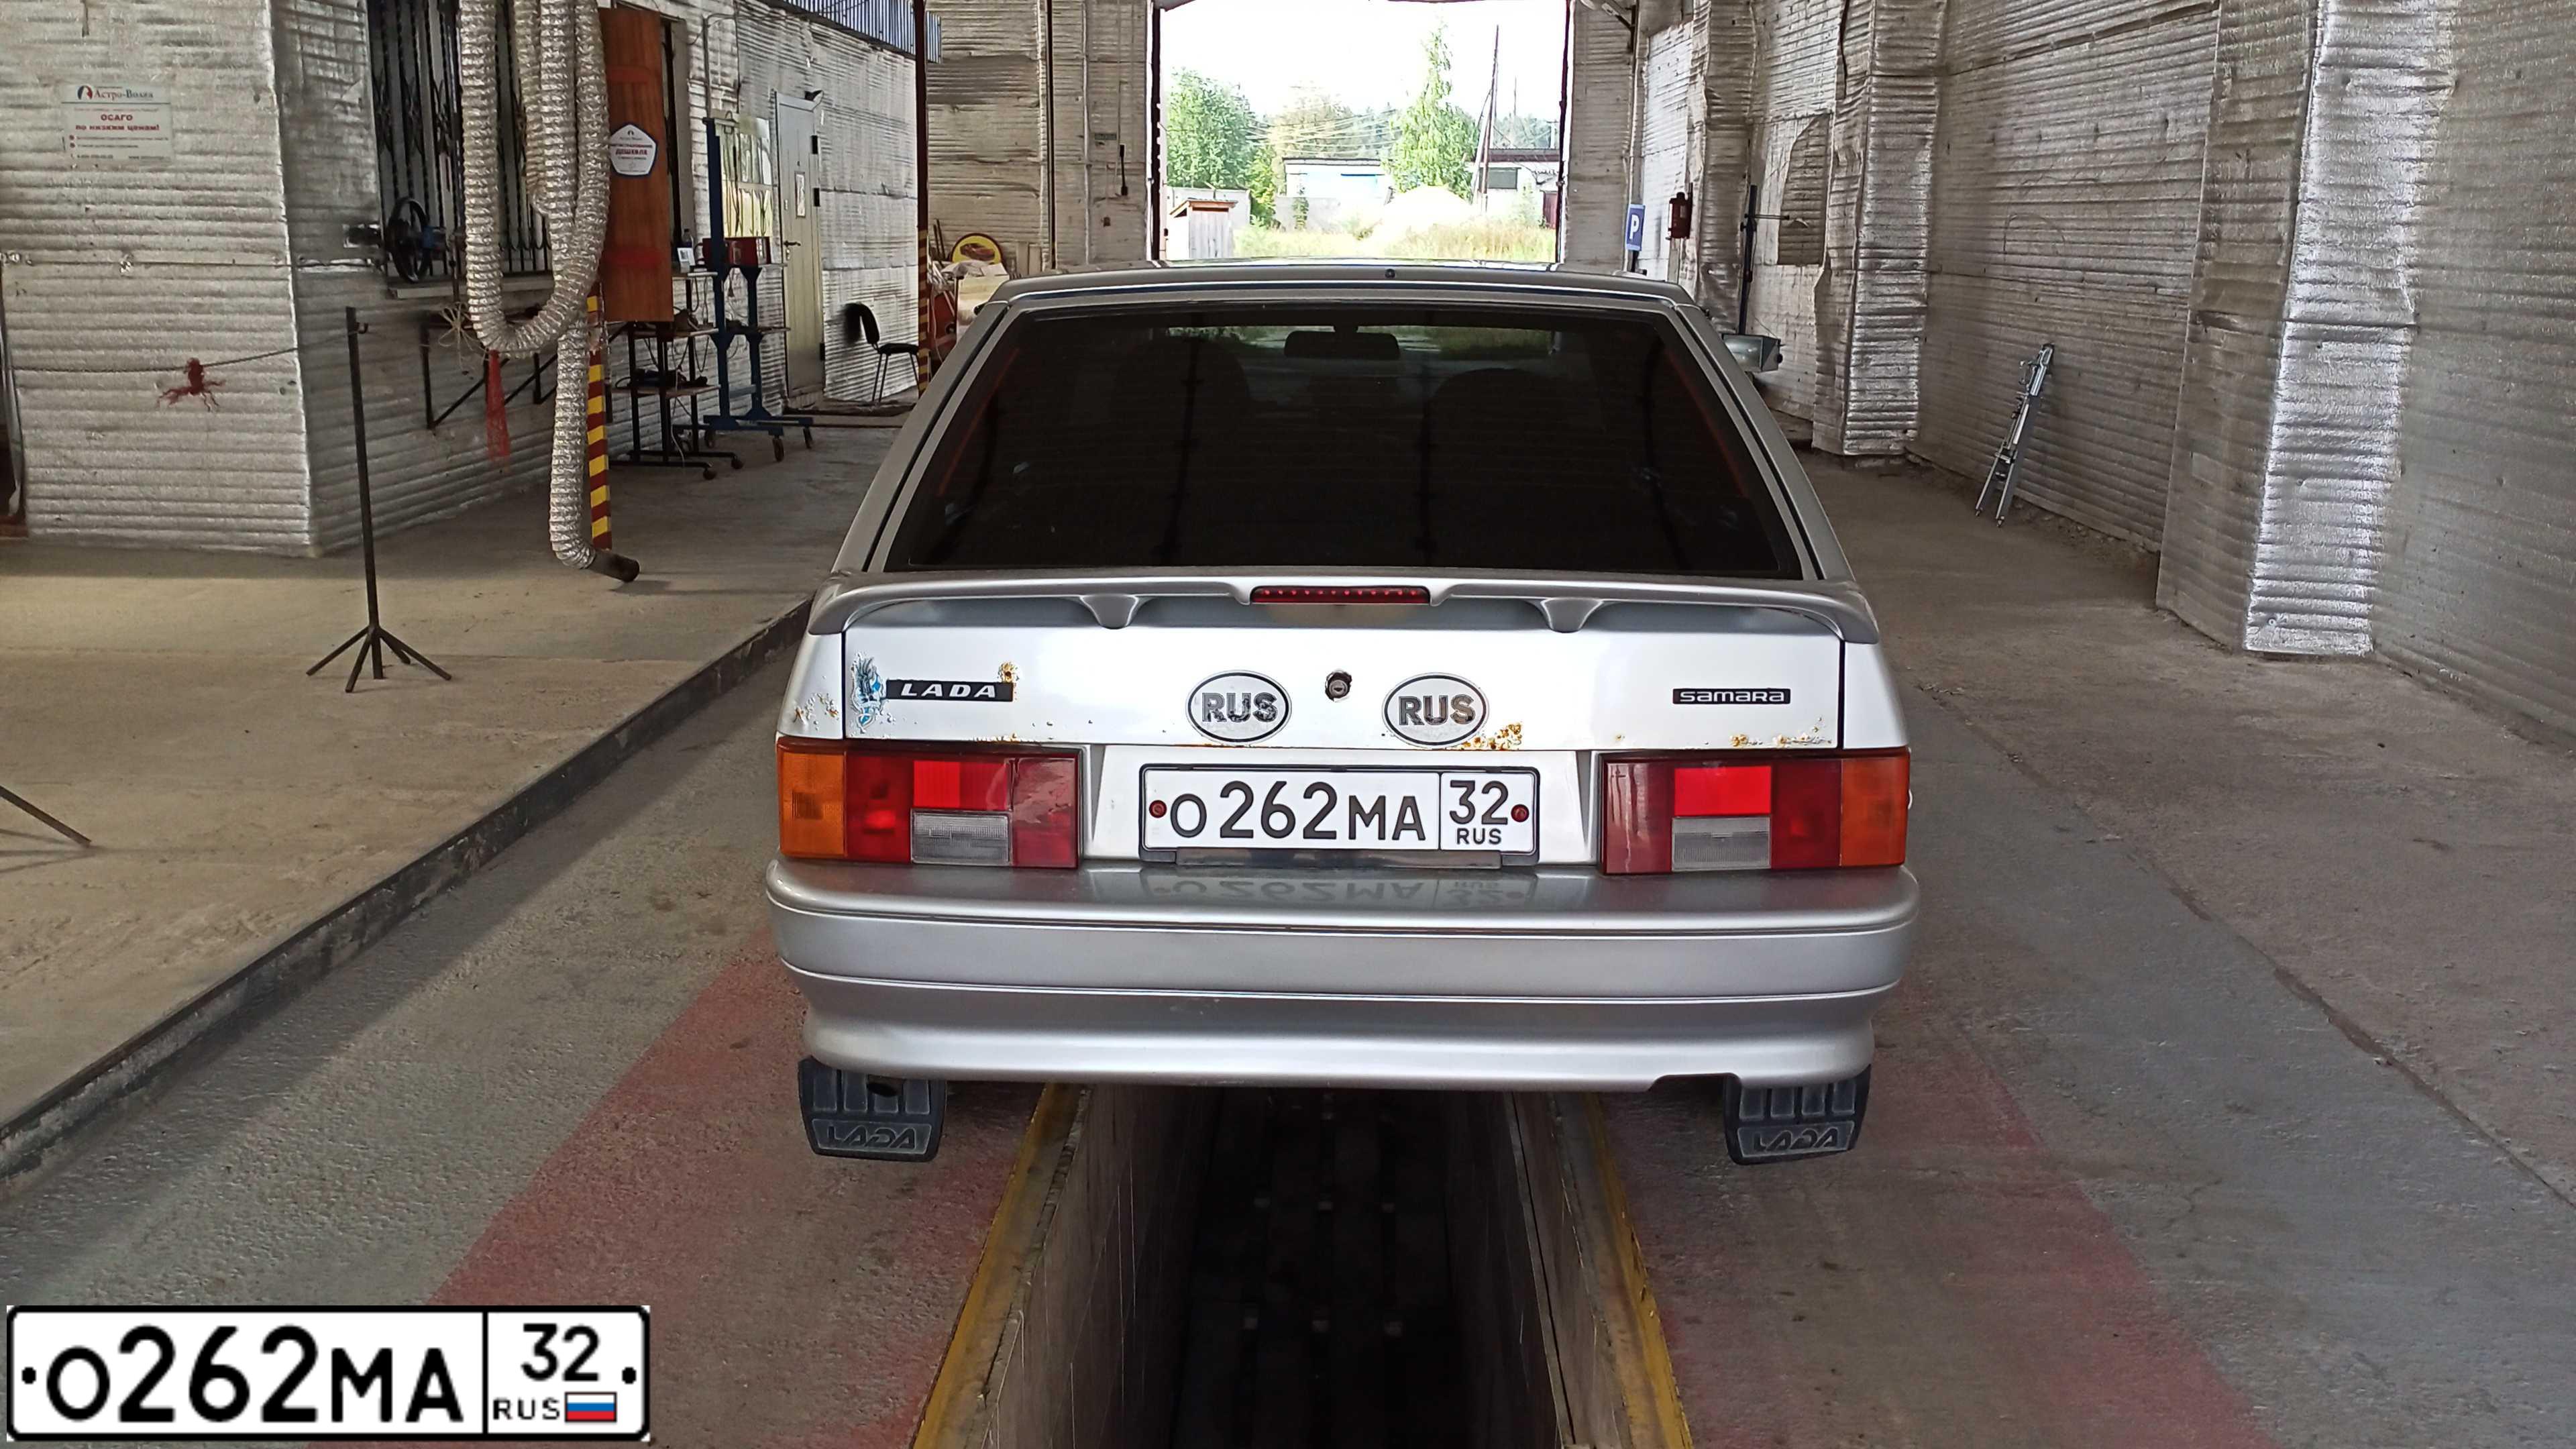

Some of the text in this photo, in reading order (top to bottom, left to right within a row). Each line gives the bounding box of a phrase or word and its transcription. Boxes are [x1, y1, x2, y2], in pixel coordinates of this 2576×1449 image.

[1629, 214, 1640, 240] P
[901, 684, 996, 698] LADA
[1201, 692, 1279, 723] RUS
[1399, 694, 1476, 726] RUS
[1449, 780, 1509, 825] 32
[1457, 828, 1502, 845] RUS
[827, 1125, 916, 1150] LADA
[1754, 1126, 1839, 1152] LADA
